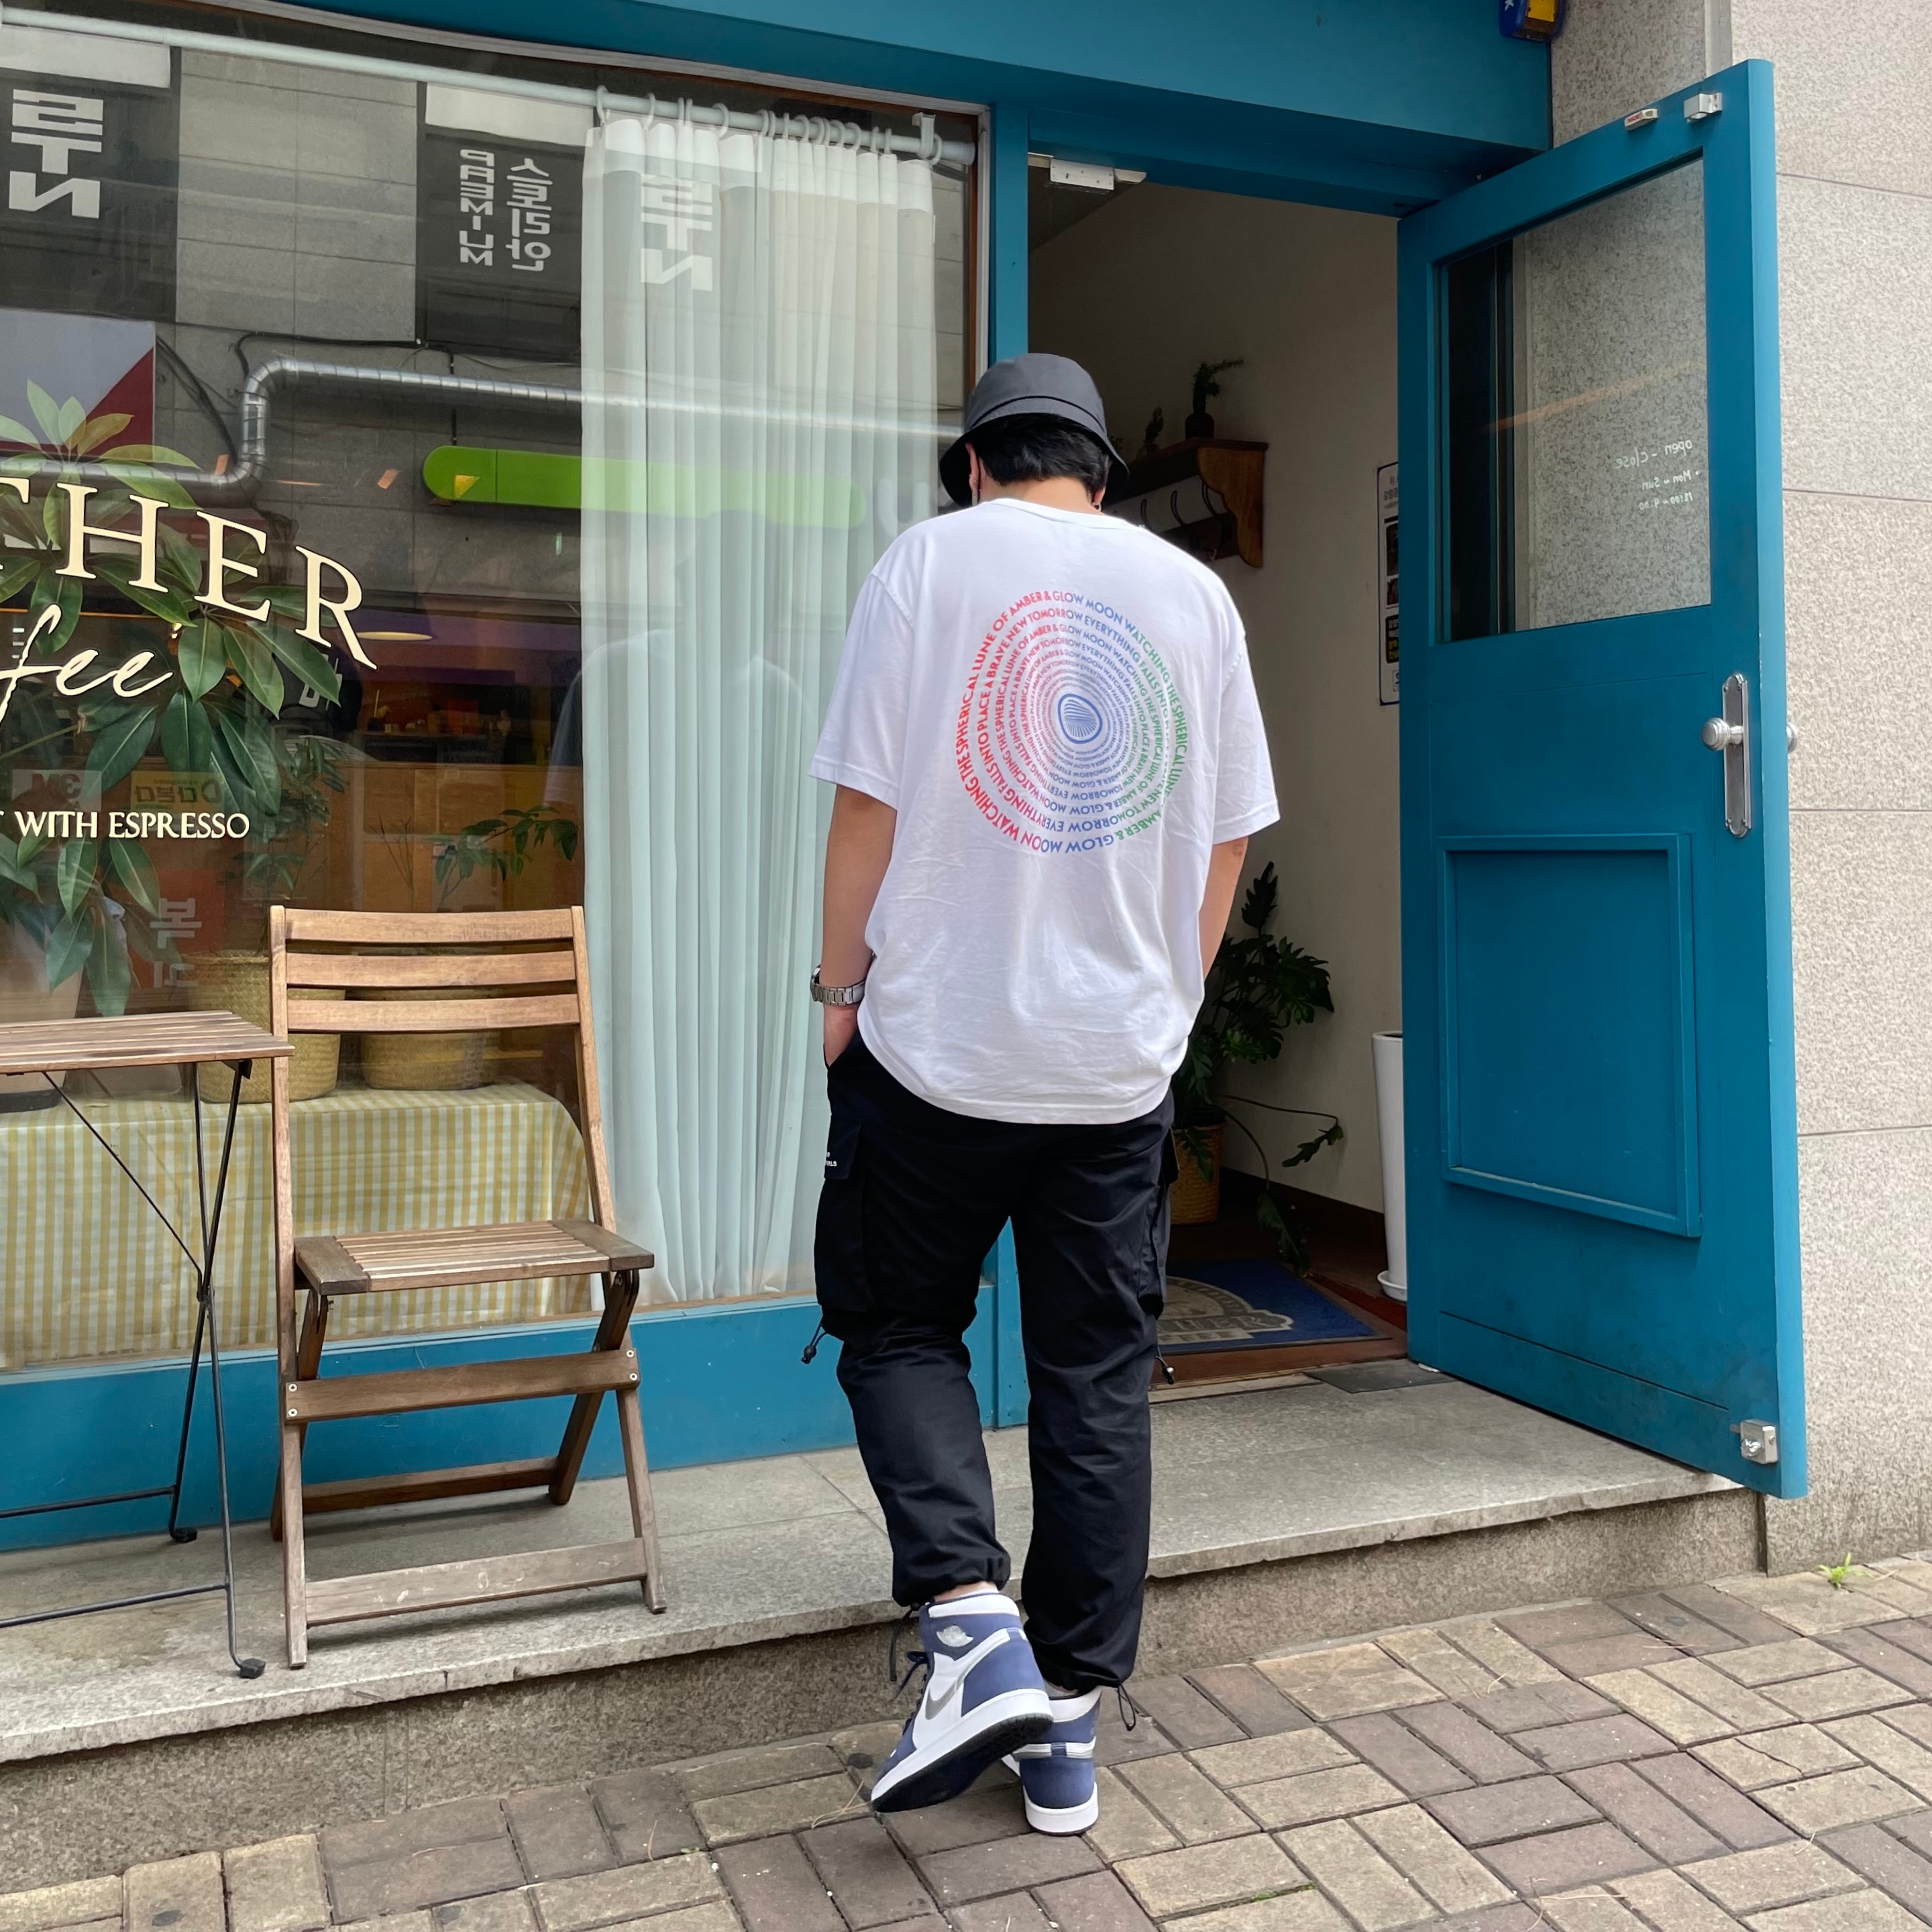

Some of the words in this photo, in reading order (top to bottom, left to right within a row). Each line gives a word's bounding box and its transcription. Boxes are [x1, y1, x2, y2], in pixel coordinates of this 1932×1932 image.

[1010, 592, 1042, 616] AMBER
[1044, 591, 1051, 600] &
[1053, 591, 1083, 604] GLOW
[993, 612, 1008, 631] OF
[1027, 608, 1083, 623] TOMORROW
[1085, 600, 1123, 625] MOON
[1006, 617, 1027, 641] NEW
[1030, 625, 1051, 641] AMBER
[1053, 624, 1059, 632] &
[1059, 624, 1082, 636] GLOW
[1084, 615, 1141, 663] EVERYTHING
[972, 633, 996, 670] LUNE
[1018, 636, 1029, 649] OF
[1083, 632, 1112, 652] MOON
[1126, 619, 1170, 684] WATCHING
[986, 640, 1010, 678] BRAVE
[1004, 649, 1021, 674] LUNE
[1114, 648, 1148, 696] WATCHING
[1139, 661, 1160, 690] FALLS
[995, 676, 1010, 732] SPHERICAL
[1144, 696, 1156, 714] THE
[1167, 683, 1179, 706] THE
[956, 674, 979, 755] SPHERICAL
[977, 691, 991, 732] PLACE
[997, 732, 1008, 753] THE
[1151, 715, 1163, 760] SPHERICAL
[1171, 705, 1187, 766] SPHERICAL
[978, 733, 994, 765] INTO
[957, 752, 974, 782] THE
[986, 763, 1008, 794] FALLS
[1003, 750, 1039, 800] WATCHING
[1144, 762, 1161, 782] LUNE
[1113, 789, 1137, 808] AMBER
[1136, 781, 1148, 793] OF
[965, 777, 1020, 841] WATCHING
[1004, 788, 1064, 832] EVERYTHING
[1039, 794, 1067, 813] MOON
[1069, 804, 1104, 815] GLOW
[1140, 789, 1162, 810] NEW
[16, 811, 98, 839] WITH
[109, 812, 250, 839] ESPRESSO
[1068, 806, 1142, 833] TOMORROW
[1124, 810, 1161, 836] AMBER
[1020, 831, 1063, 853] MOON
[1065, 835, 1114, 853] GLOW
[1114, 830, 1124, 840] &
